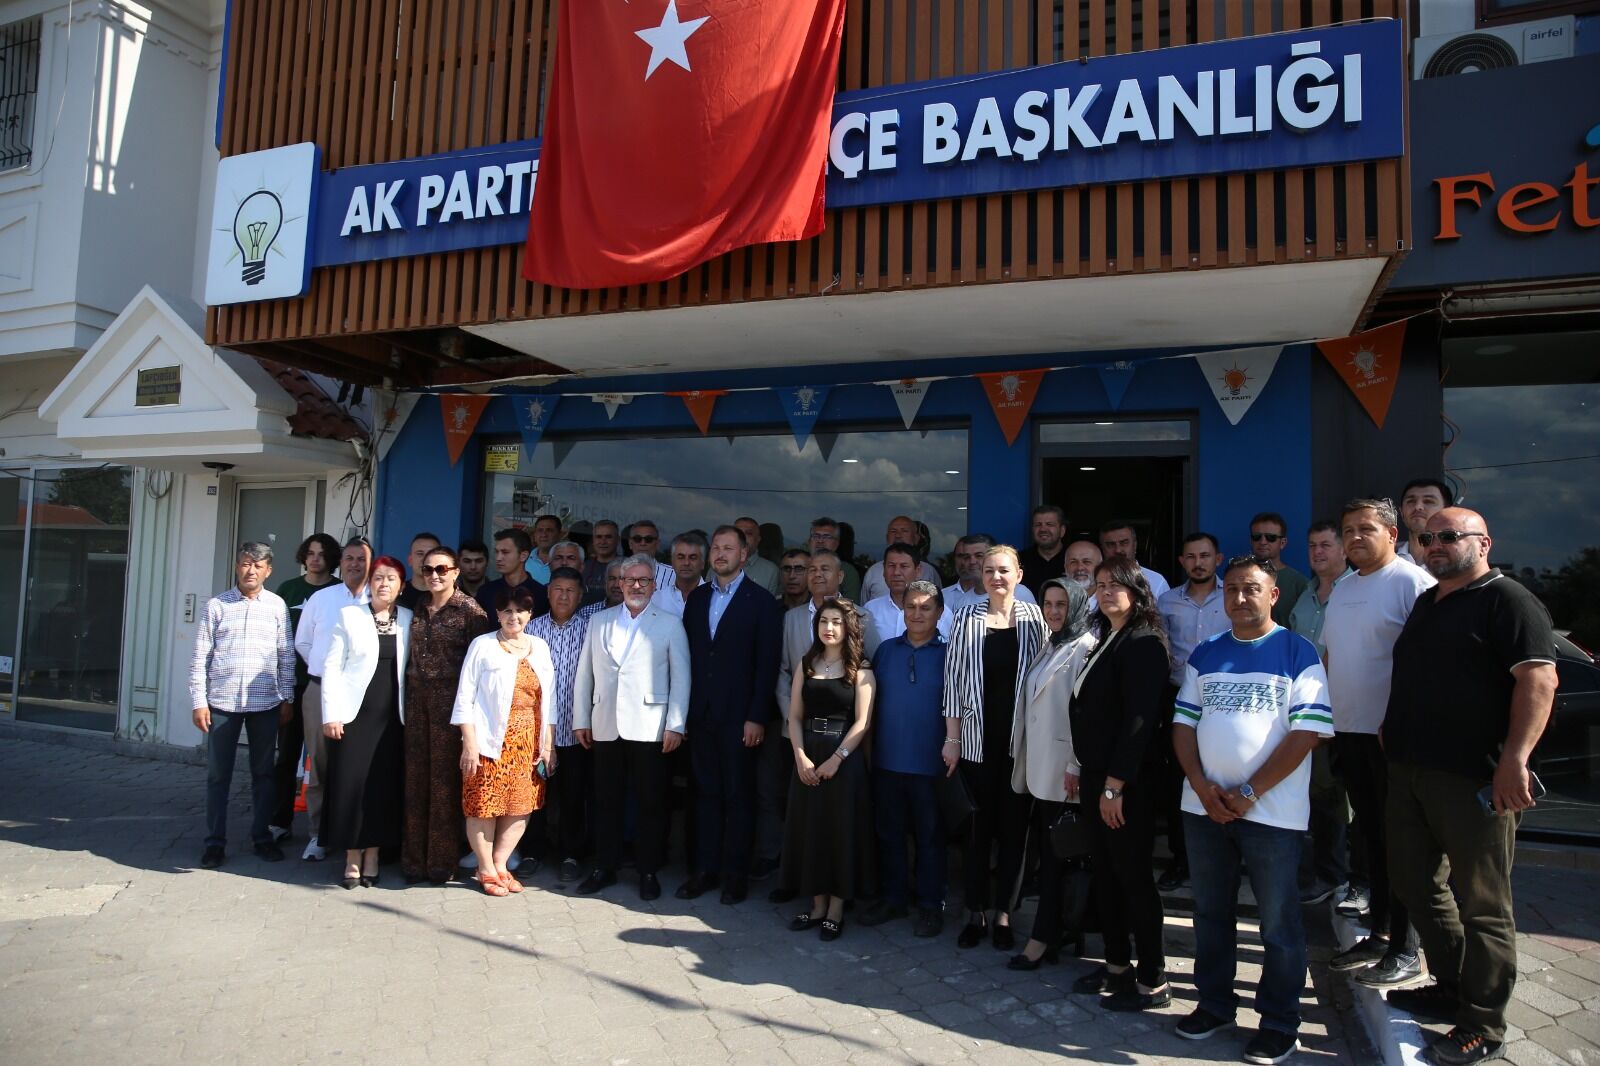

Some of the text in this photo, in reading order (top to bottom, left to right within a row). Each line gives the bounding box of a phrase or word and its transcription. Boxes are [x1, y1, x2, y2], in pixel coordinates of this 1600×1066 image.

[1530, 27, 1563, 40] airfel
[340, 179, 405, 237] AK
[825, 109, 899, 179] ÇE
[923, 40, 1362, 164] BAŞKANLIĞI
[1203, 681, 1286, 700] SPEED
[1202, 694, 1284, 712] CIRCUIT
